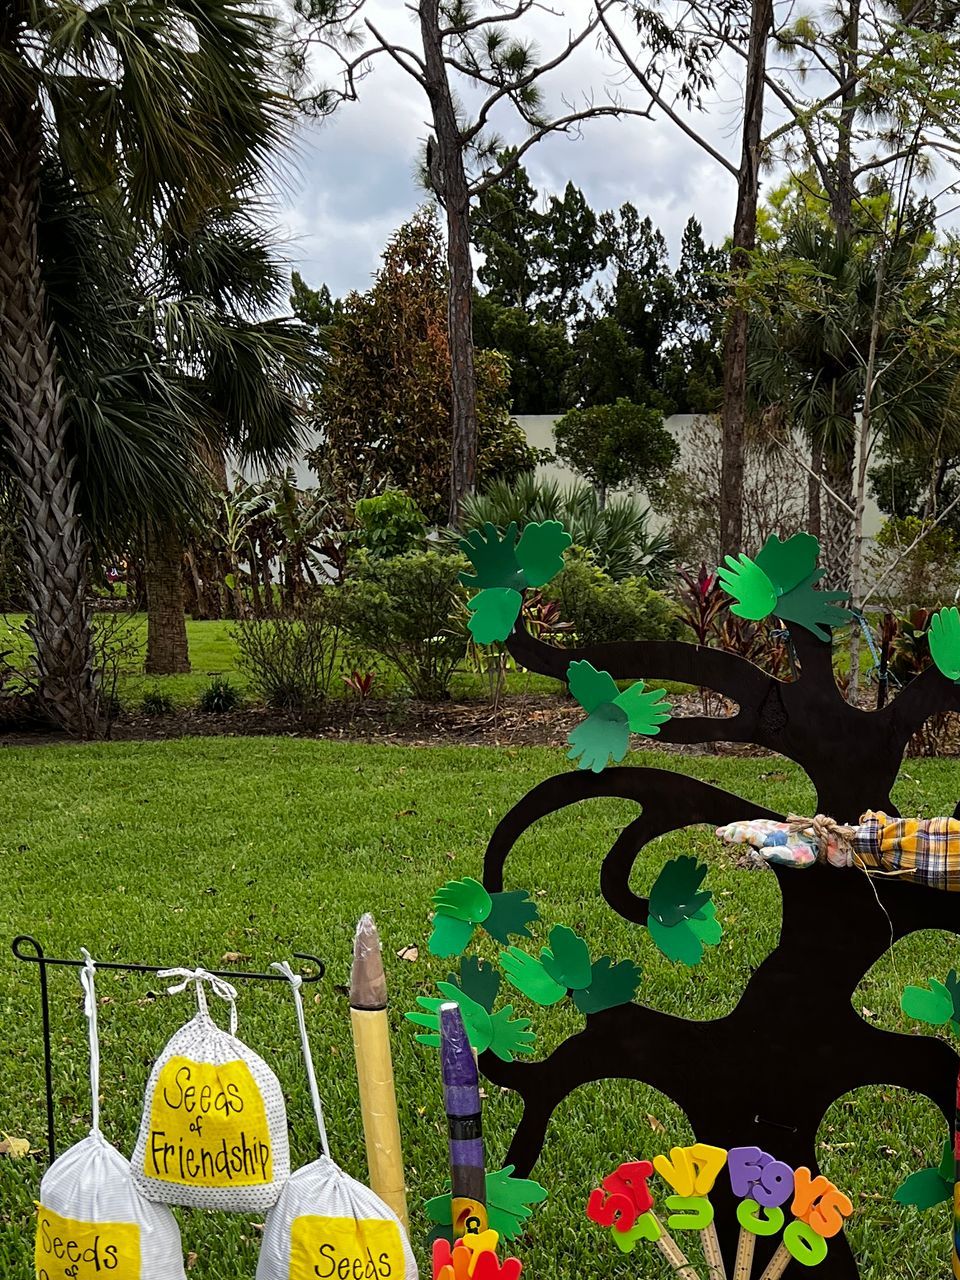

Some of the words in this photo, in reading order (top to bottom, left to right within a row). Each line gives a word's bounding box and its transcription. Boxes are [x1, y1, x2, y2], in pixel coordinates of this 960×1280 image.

[164, 1066, 244, 1117] Seeds
[189, 1115, 203, 1137] of
[151, 1131, 269, 1180] Friendship
[42, 1219, 118, 1271] Seeds
[64, 1264, 79, 1280] of
